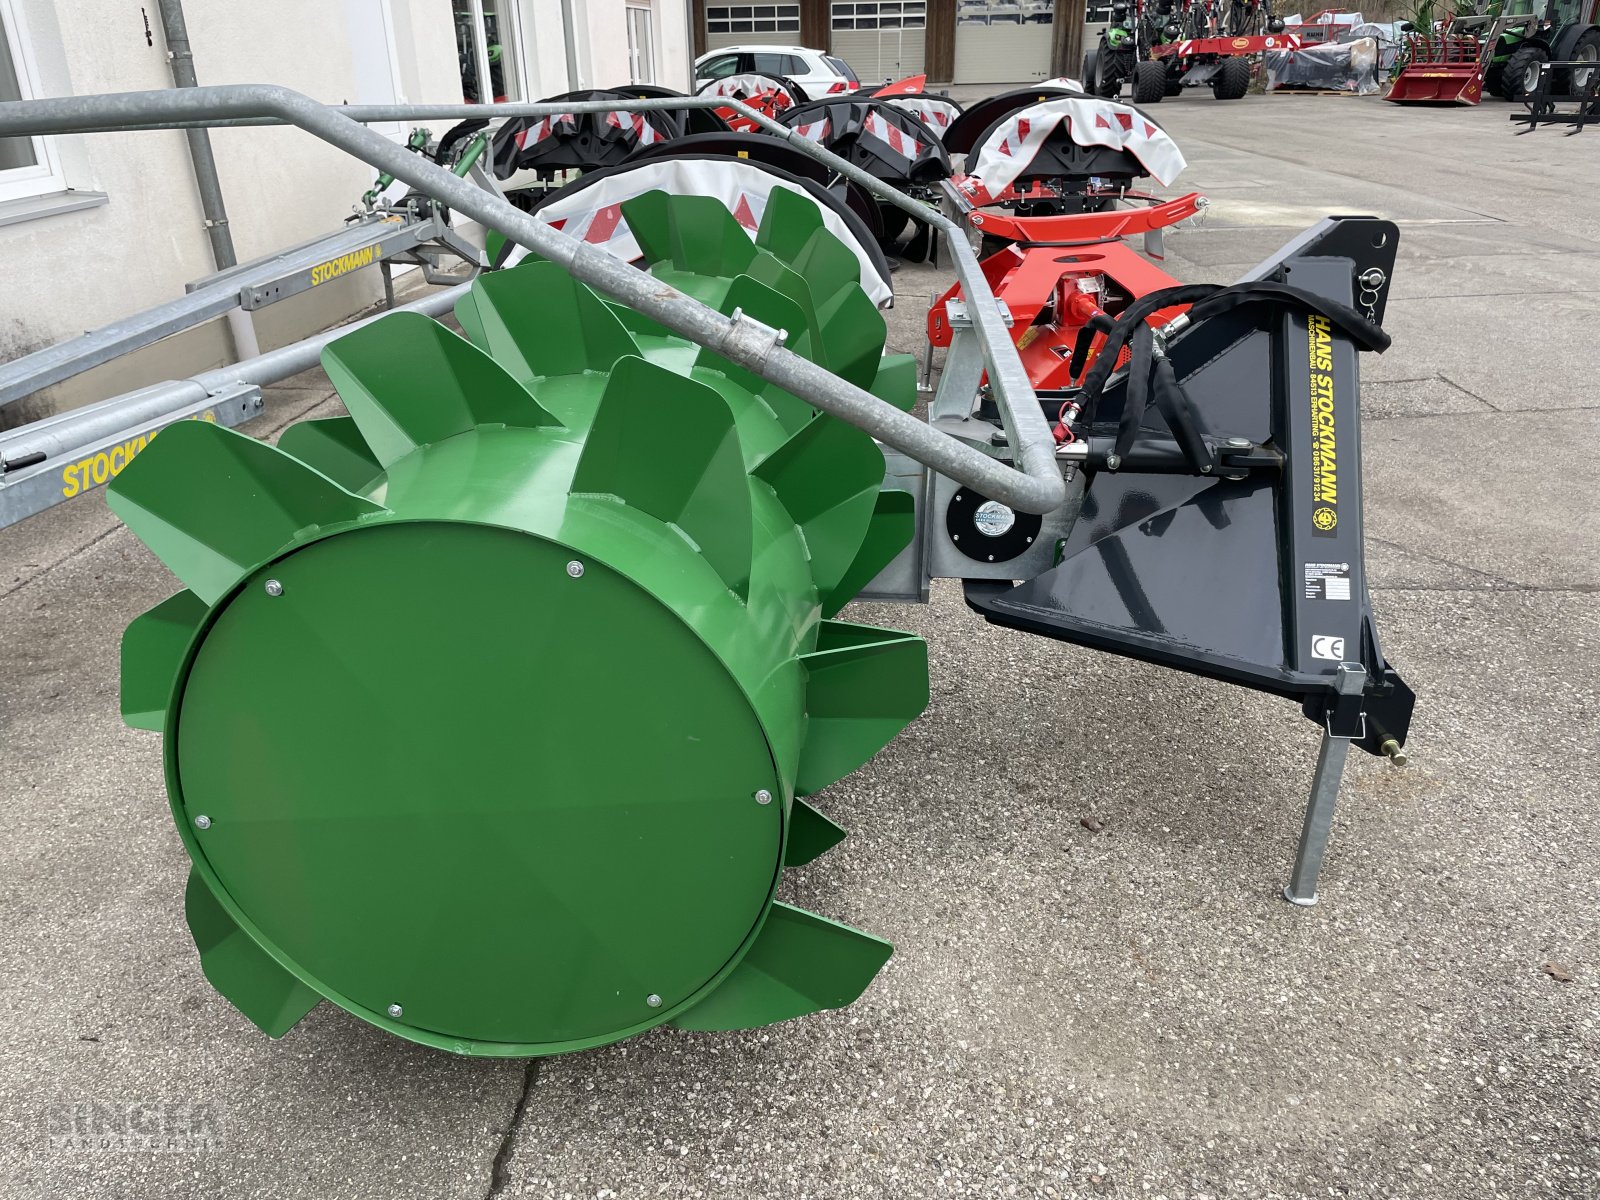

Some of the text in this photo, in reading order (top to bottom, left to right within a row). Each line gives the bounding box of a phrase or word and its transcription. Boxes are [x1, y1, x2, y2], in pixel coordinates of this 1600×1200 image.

[311, 245, 373, 286] STOCKMANN
[1308, 314, 1317, 370] MASCHINENBAU
[1310, 373, 1318, 396] 84513
[1311, 397, 1320, 437] ERHARTING
[1315, 315, 1337, 504] HANS STOCKMANN
